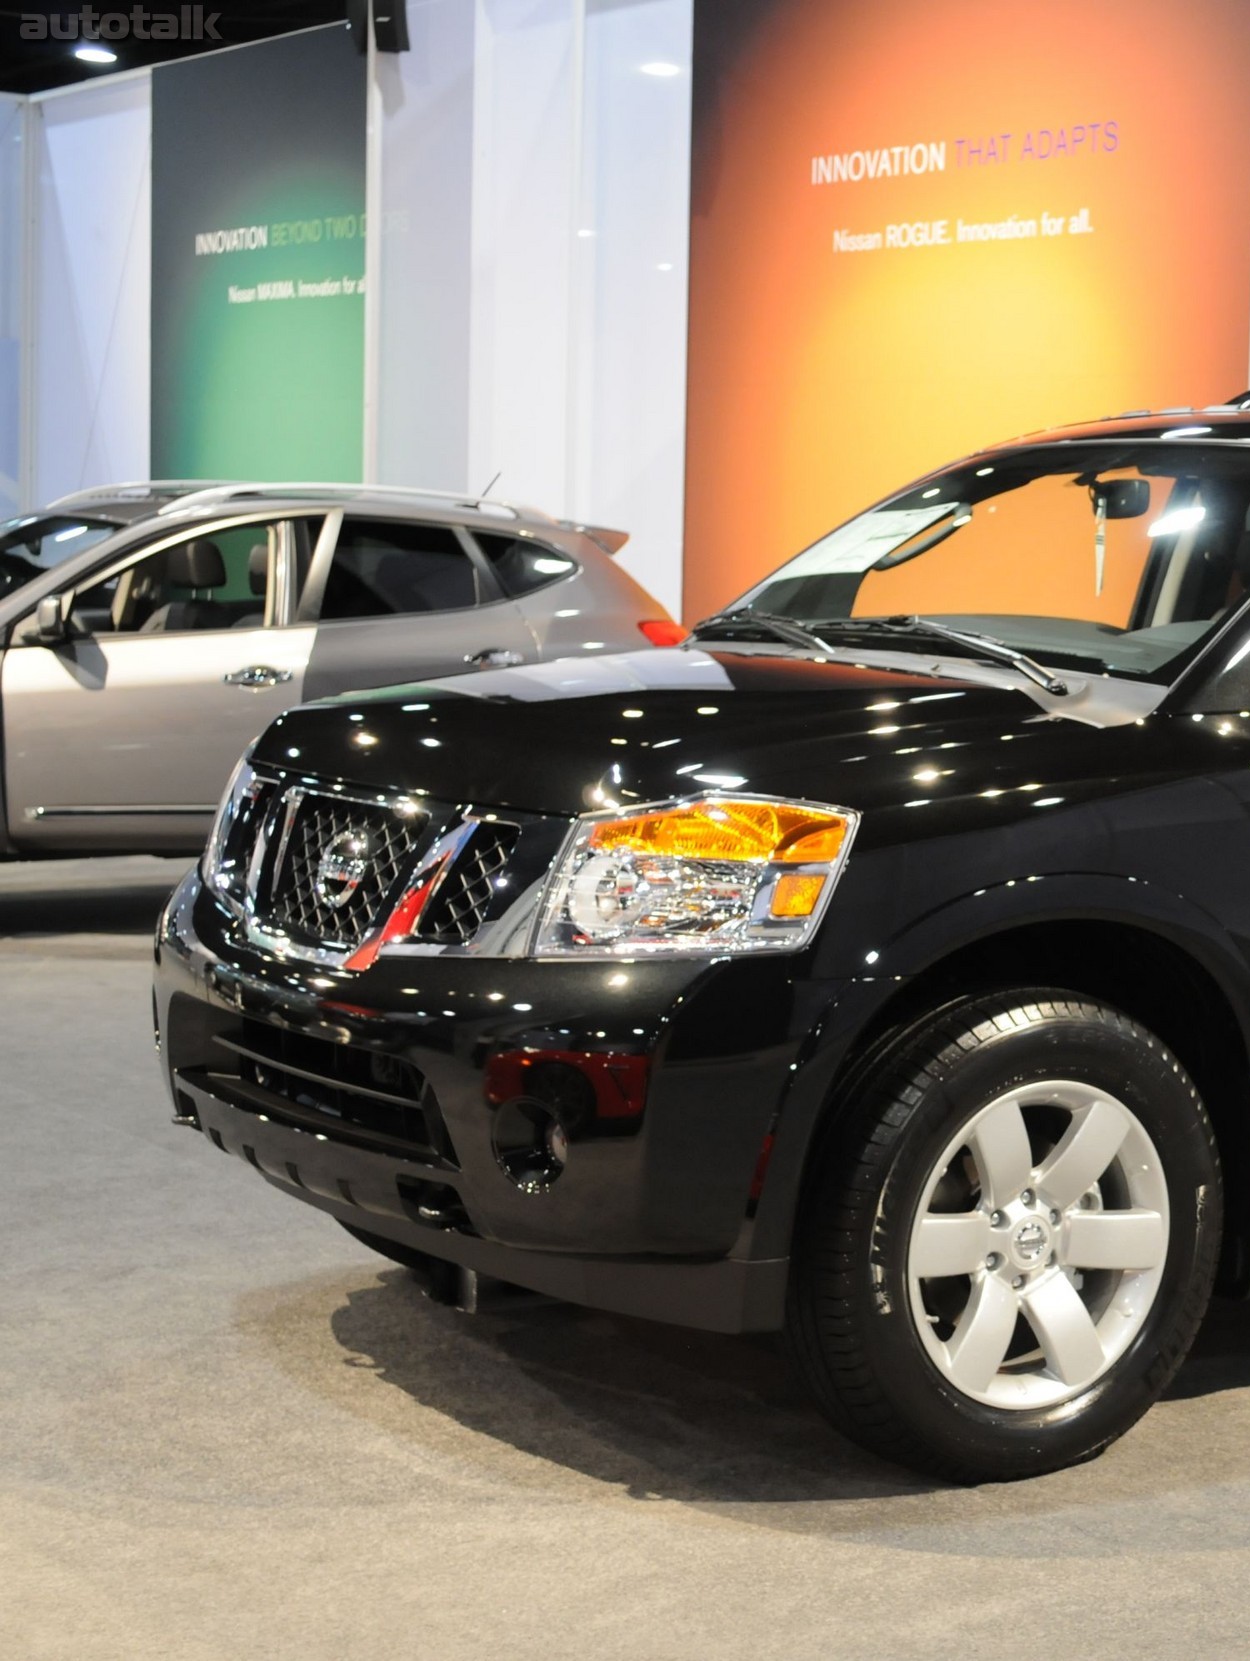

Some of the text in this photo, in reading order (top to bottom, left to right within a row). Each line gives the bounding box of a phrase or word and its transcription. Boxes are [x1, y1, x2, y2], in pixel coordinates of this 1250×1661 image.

[811, 120, 1119, 185] INNOVATION THAT ADAPTS
[195, 225, 268, 256] INNOVATION
[271, 219, 322, 247] BEYOND
[325, 214, 357, 240] TWO
[833, 207, 1094, 253] Nissan ROGUE. Innovation for all.
